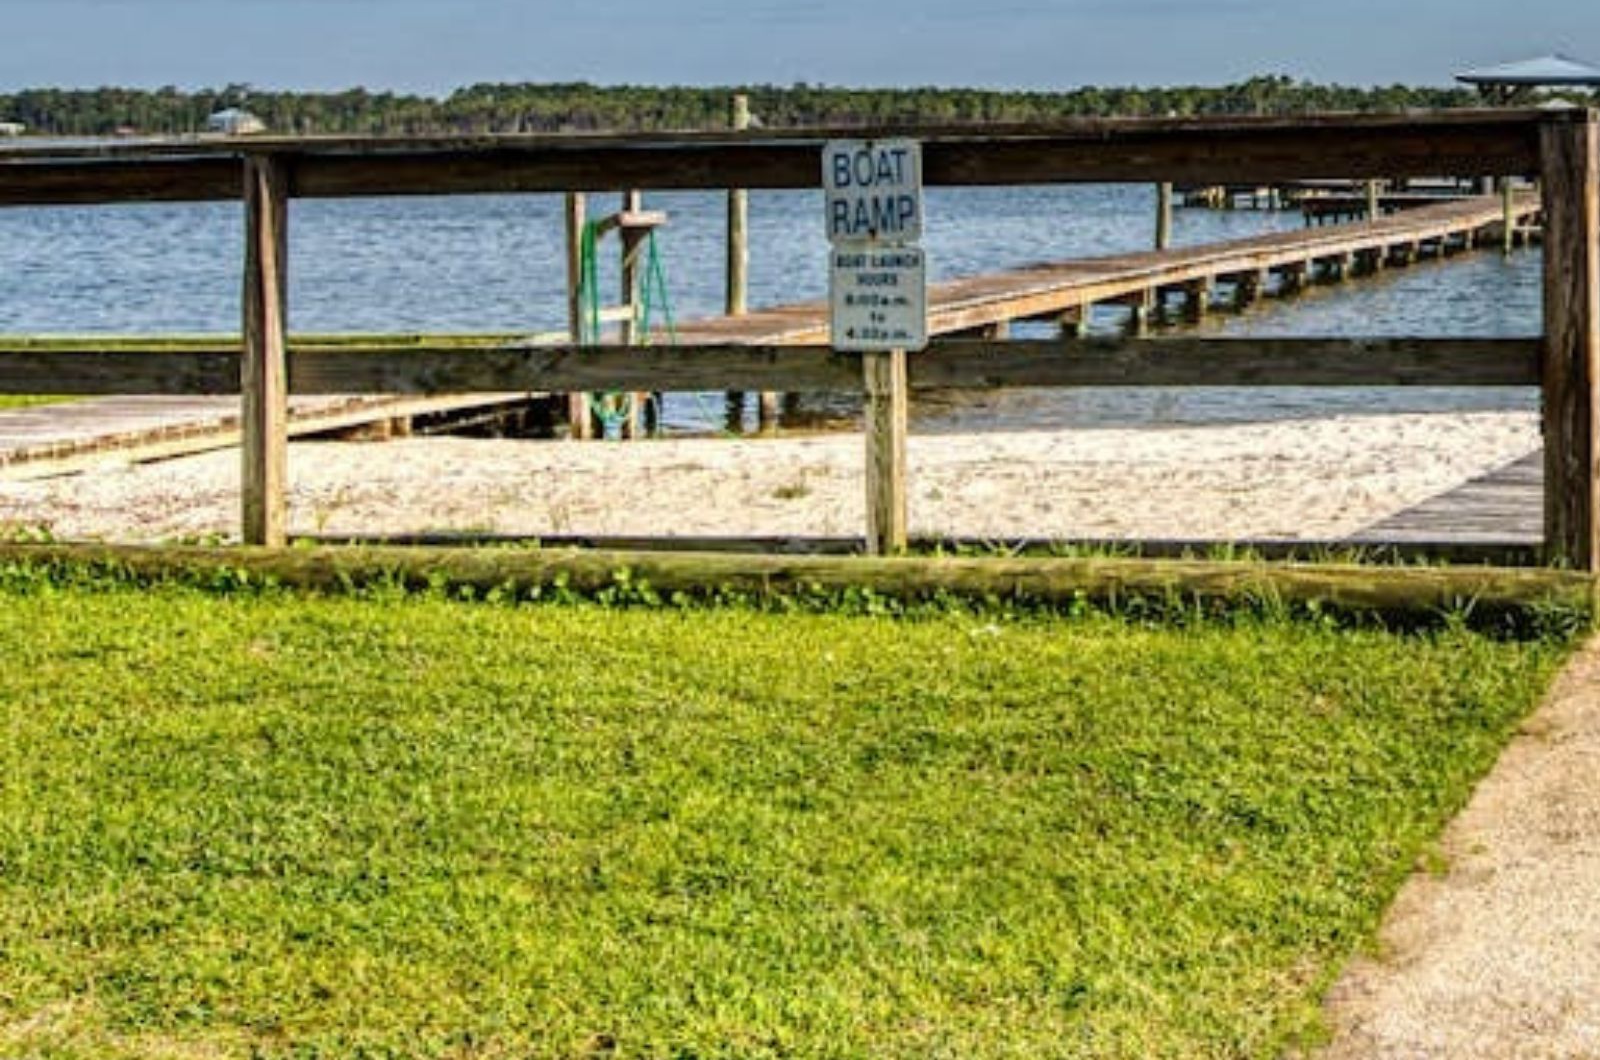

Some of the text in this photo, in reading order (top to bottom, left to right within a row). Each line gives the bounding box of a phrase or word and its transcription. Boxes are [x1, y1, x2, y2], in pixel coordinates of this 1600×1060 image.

[833, 150, 907, 187] BOAT
[832, 195, 914, 234] RAMP
[836, 254, 919, 268] BOAT LAUNCH
[856, 273, 897, 286] HOURS
